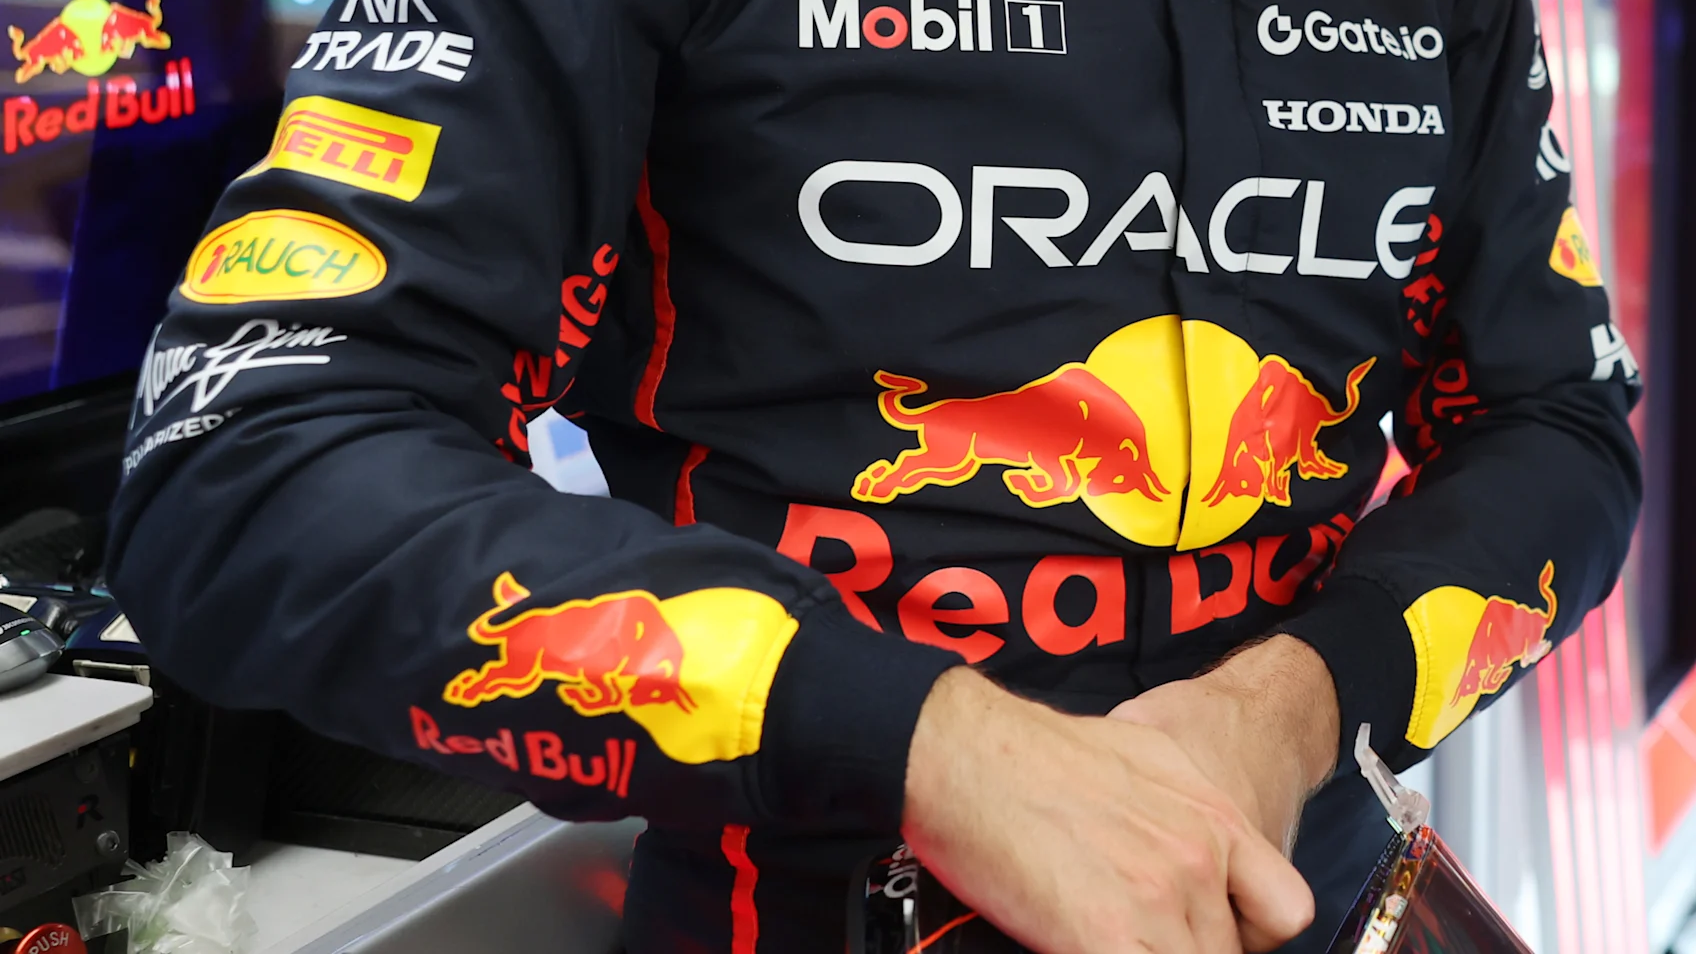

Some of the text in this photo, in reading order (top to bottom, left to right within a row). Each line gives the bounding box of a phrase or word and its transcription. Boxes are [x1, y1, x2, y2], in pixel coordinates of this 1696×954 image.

[291, 30, 475, 82] TRADE
[1304, 10, 1445, 61] Gate.io
[4, 58, 195, 154] Red Bull
[1262, 99, 1447, 136] HONDA
[798, 160, 1436, 280] ORACLE
[220, 237, 360, 284] RAUCH
[410, 706, 637, 798] Red Bull
